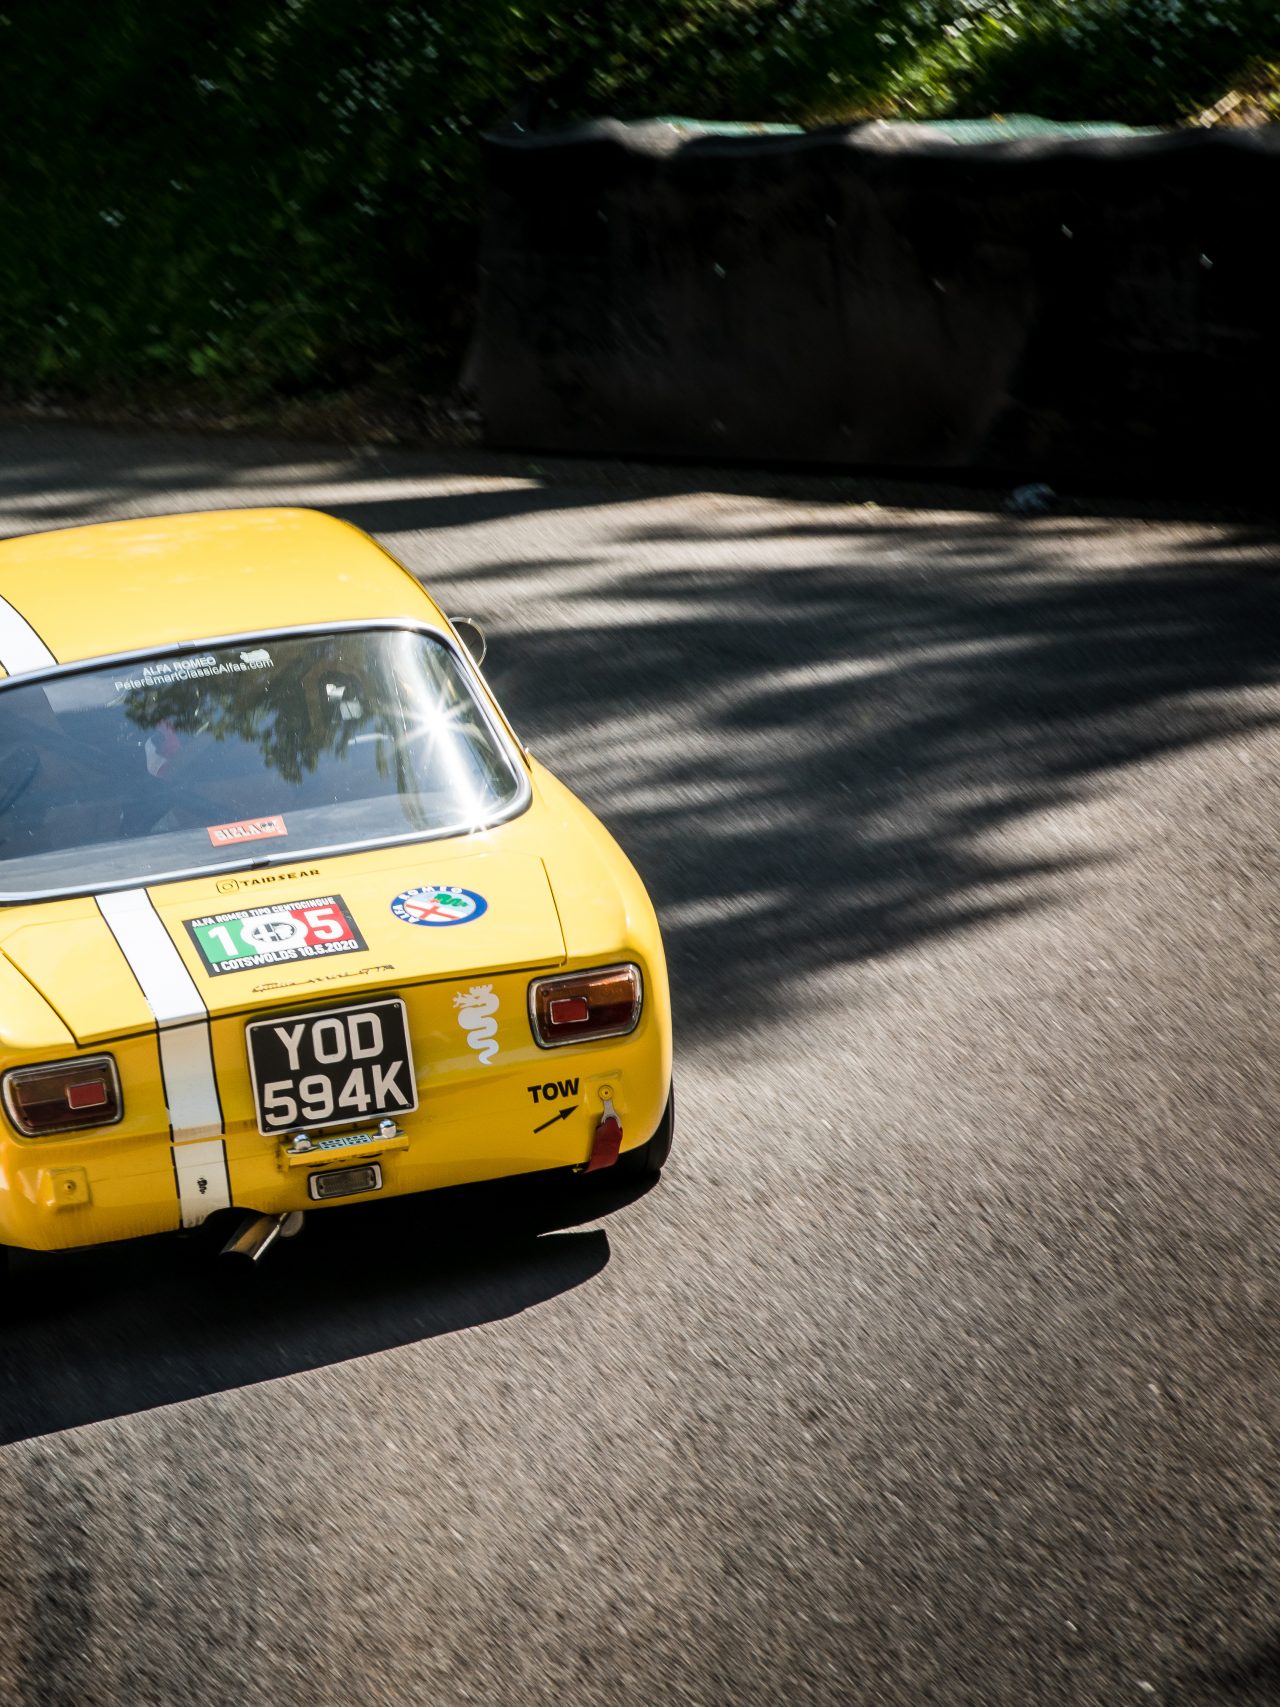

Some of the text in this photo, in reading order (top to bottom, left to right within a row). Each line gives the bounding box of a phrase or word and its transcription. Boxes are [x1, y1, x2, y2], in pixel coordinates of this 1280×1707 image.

[143, 656, 217, 676] ALFA ROMEO
[191, 917, 215, 928] ALFA
[215, 911, 249, 923] ROMEO
[249, 907, 271, 918] TIPO
[220, 947, 297, 971] COTSWOLDS
[300, 939, 359, 958] 10.5.2020
[274, 1012, 384, 1071] YOD
[264, 1060, 410, 1126] 594K
[527, 1077, 580, 1104] TOW
